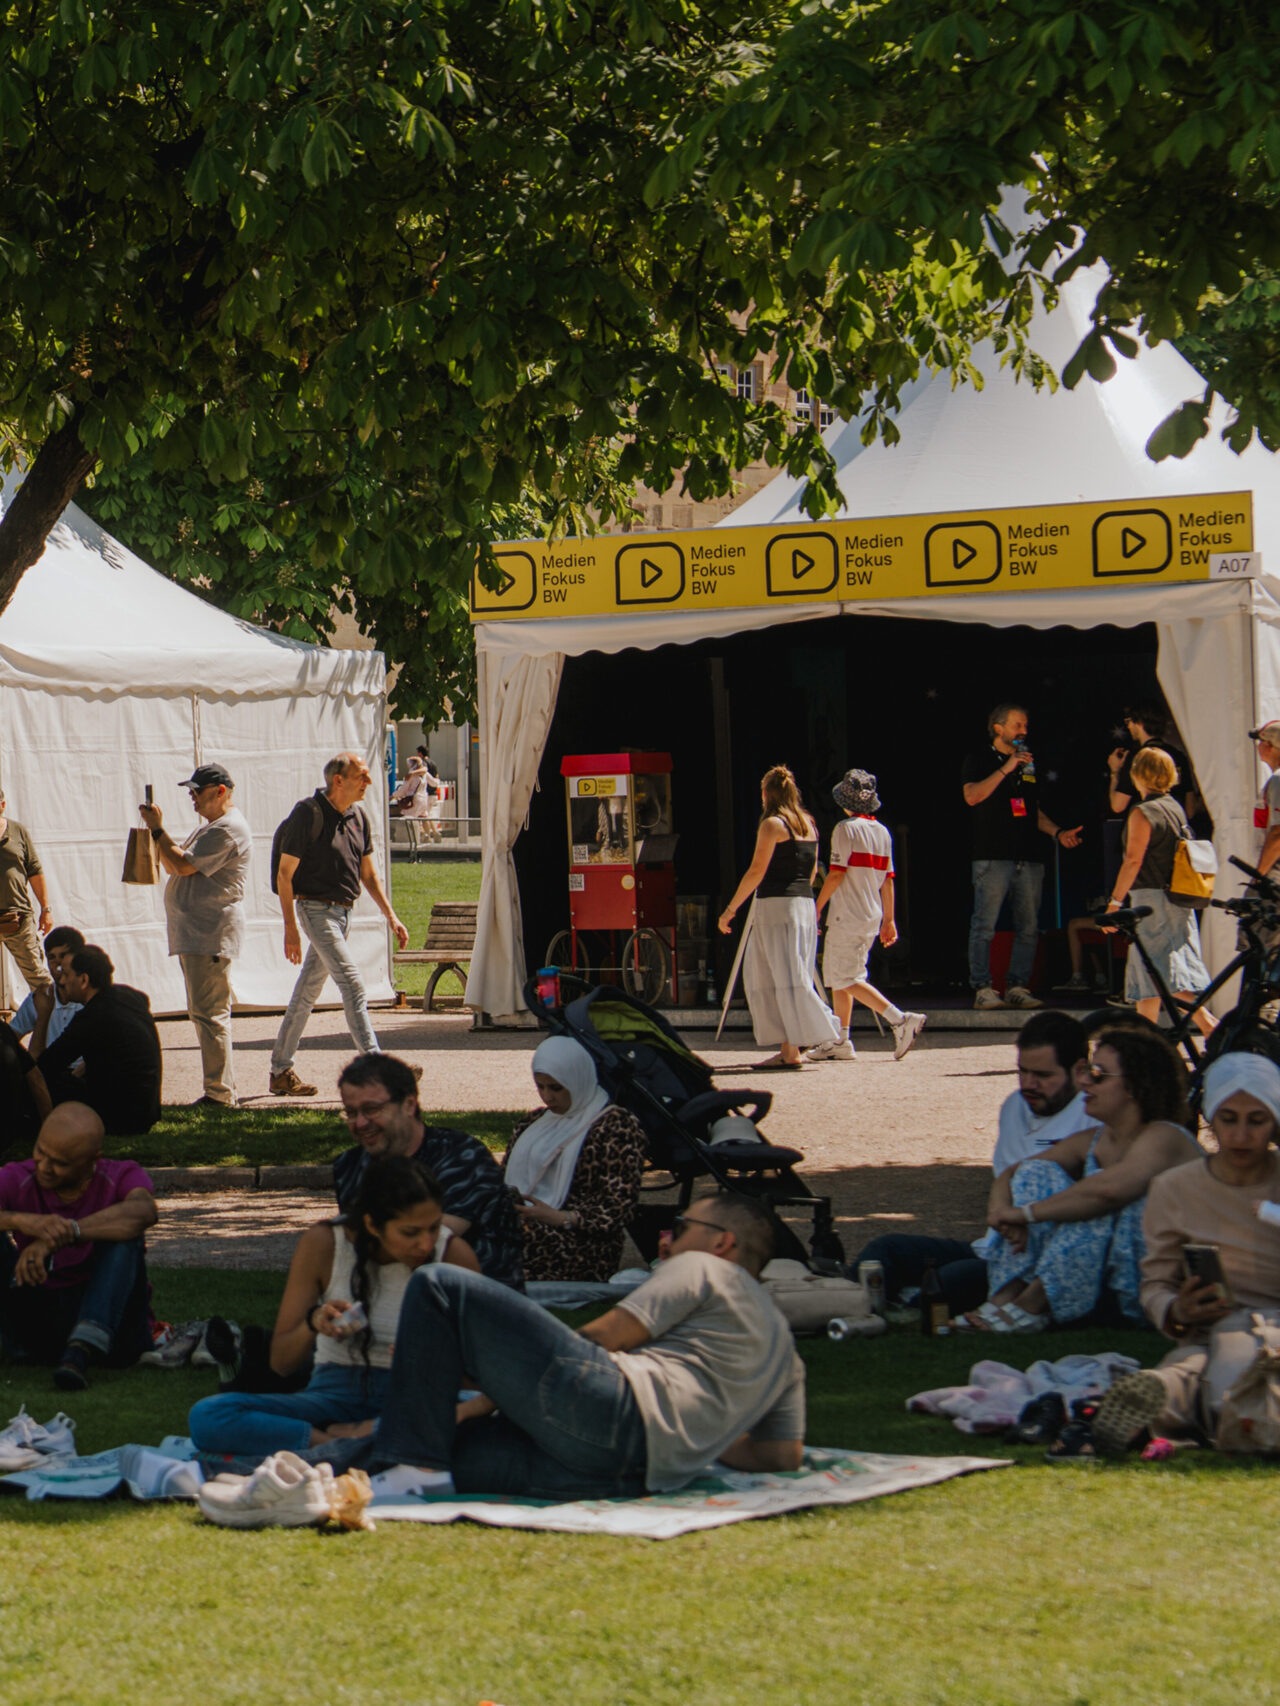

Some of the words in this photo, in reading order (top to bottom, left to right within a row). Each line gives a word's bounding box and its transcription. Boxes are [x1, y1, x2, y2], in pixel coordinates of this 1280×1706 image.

[1179, 510, 1245, 528] Medien
[1008, 523, 1070, 539] Medien
[1180, 531, 1232, 546] Fokus
[845, 534, 903, 550] Medien
[1008, 542, 1058, 557] Fokus
[690, 545, 746, 560] Medien
[1180, 550, 1210, 566] BW
[542, 554, 596, 569] Medien
[845, 553, 893, 568] Fokus
[1218, 558, 1251, 573] A07
[691, 563, 736, 577] Fokus
[1009, 561, 1037, 576] BW
[542, 572, 585, 586] Fokus
[846, 571, 873, 586] BW
[692, 580, 718, 595] BW
[543, 589, 567, 603] BW
